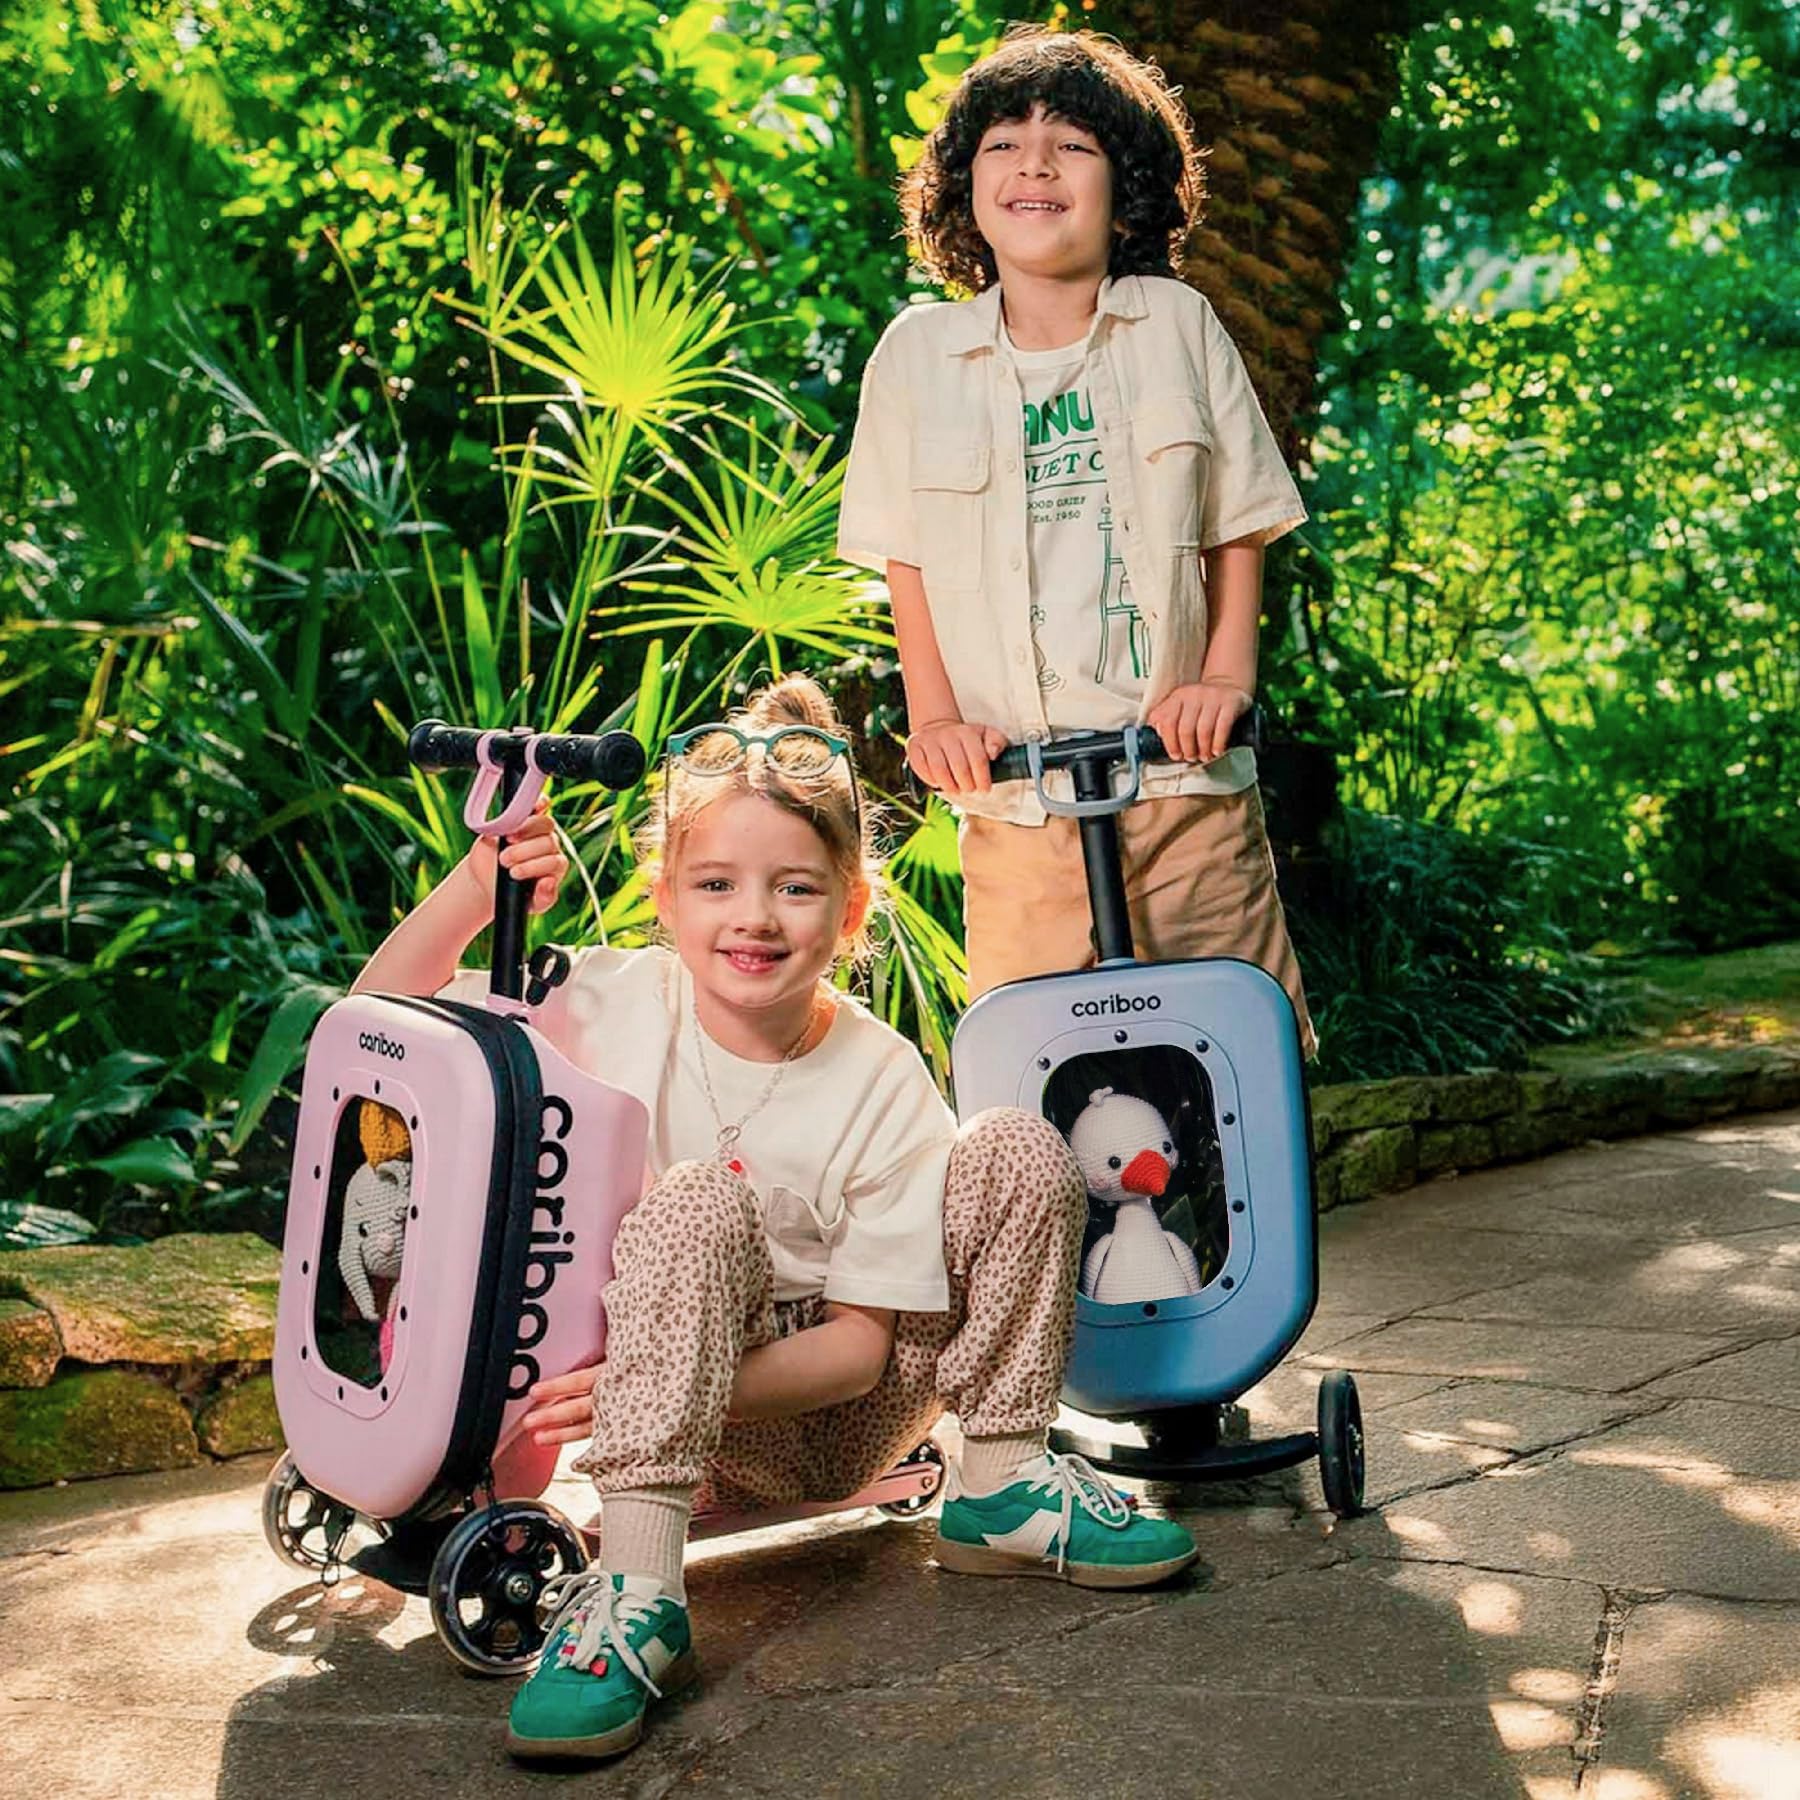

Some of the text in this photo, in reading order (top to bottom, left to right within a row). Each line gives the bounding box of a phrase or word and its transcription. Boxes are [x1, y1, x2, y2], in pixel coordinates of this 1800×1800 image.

[1025, 452, 1081, 484] UET
[1055, 510, 1081, 522] 1950
[1071, 993, 1162, 1017] cariboo
[359, 1031, 405, 1062] cariboo
[505, 1095, 575, 1401] cariboo
